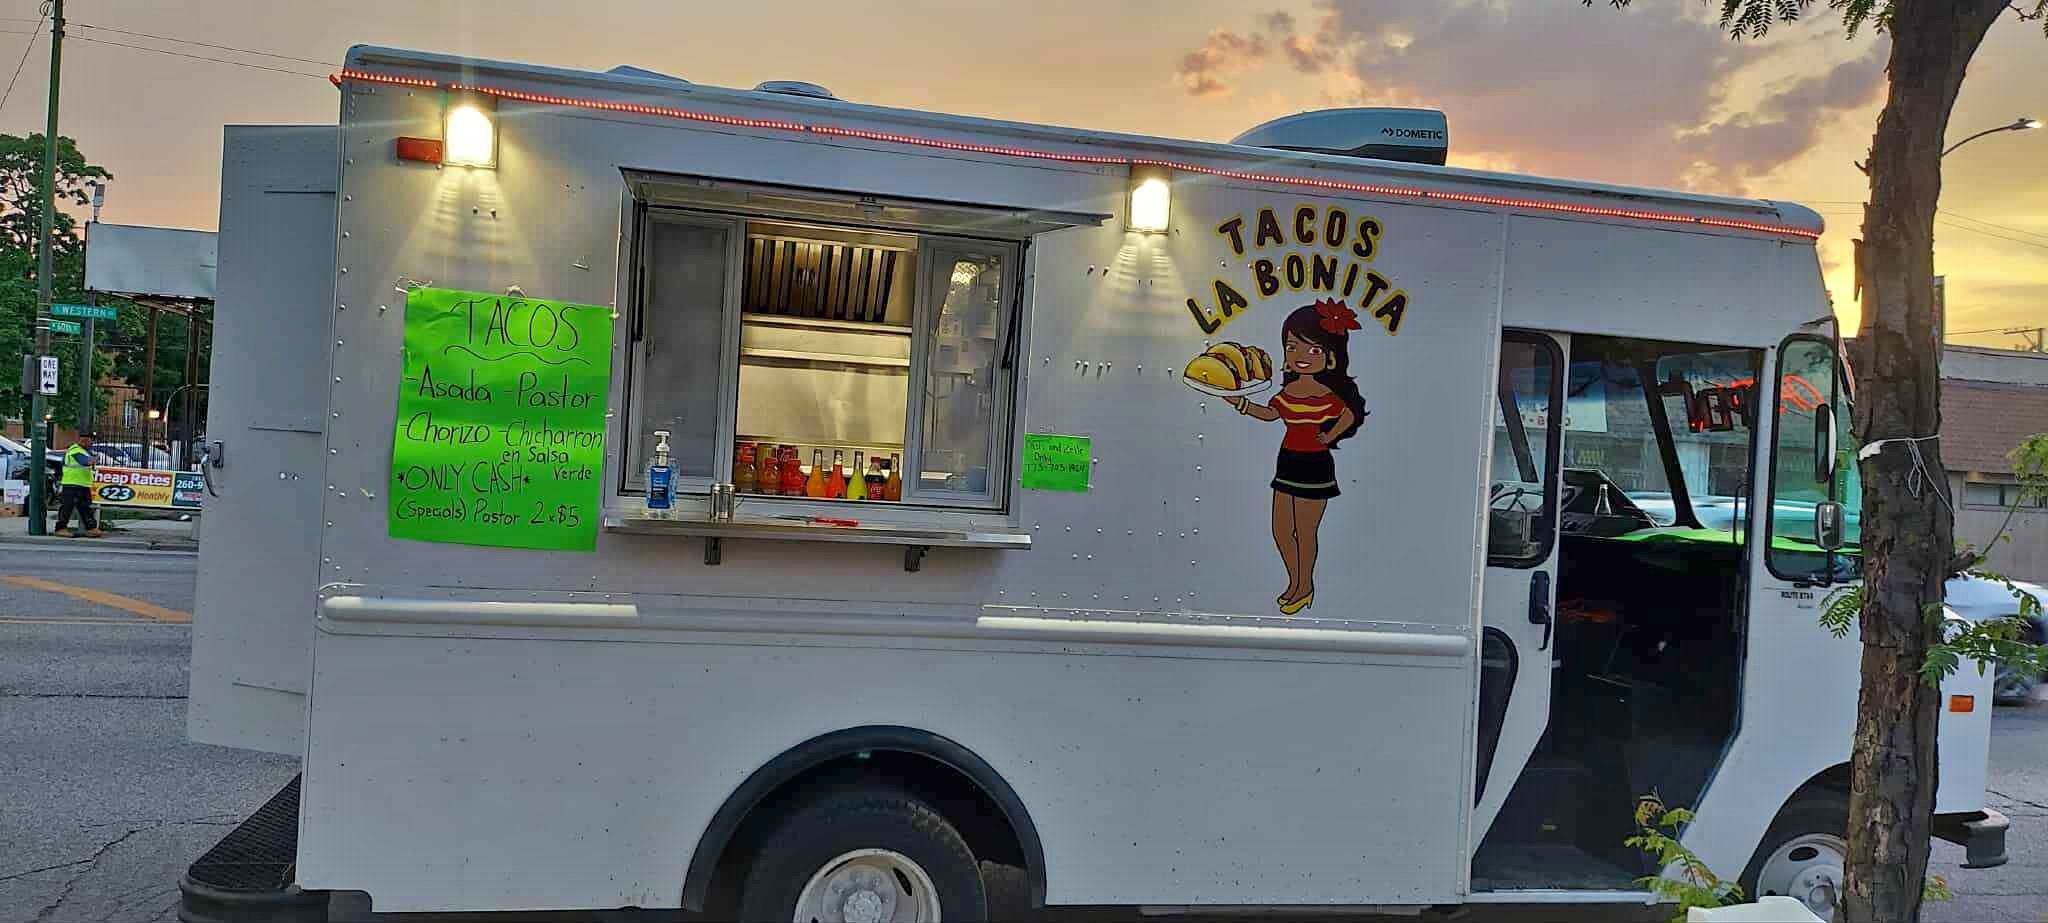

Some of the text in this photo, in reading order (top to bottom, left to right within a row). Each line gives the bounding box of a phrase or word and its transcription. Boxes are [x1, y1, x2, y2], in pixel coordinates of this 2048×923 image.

[1395, 128, 1443, 140] DOMETIC
[1216, 203, 1383, 261] TACOS
[1184, 253, 1409, 337] LA BONITA
[62, 306, 106, 318] WESTERN
[449, 297, 580, 352] TACOS
[43, 359, 56, 369] ONE
[43, 370, 56, 380] WAY
[502, 446, 569, 464] en Salsa
[95, 470, 171, 486] heap Rates
[553, 465, 592, 482] Verde
[102, 487, 130, 500] $23
[137, 490, 171, 502] Monthly
[473, 498, 520, 525] Pastor
